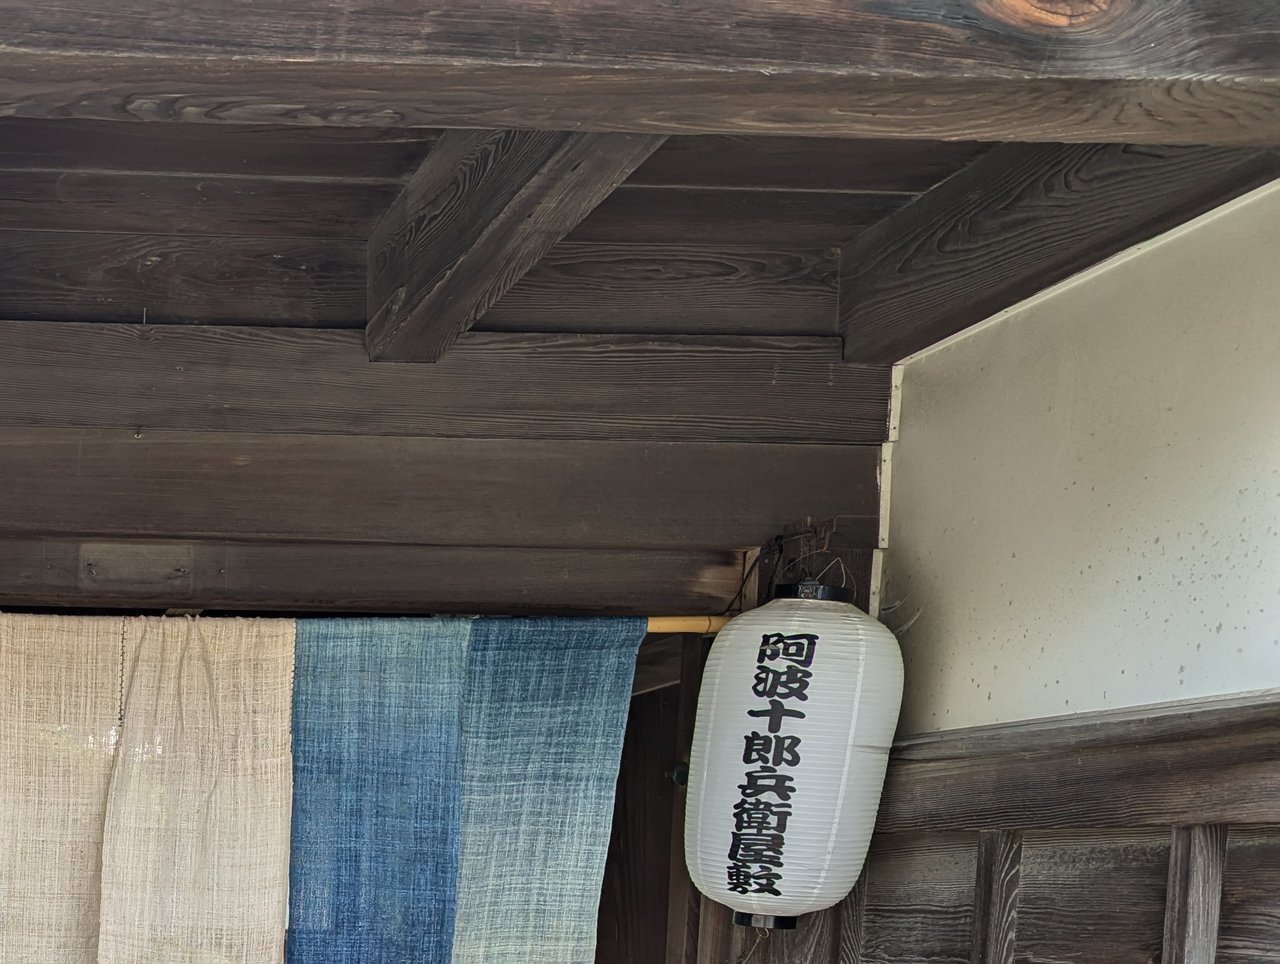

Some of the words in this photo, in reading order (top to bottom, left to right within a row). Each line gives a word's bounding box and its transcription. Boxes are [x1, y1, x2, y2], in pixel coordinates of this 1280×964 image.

[726, 632, 820, 897] 阿波十郎兵衛屋敷
